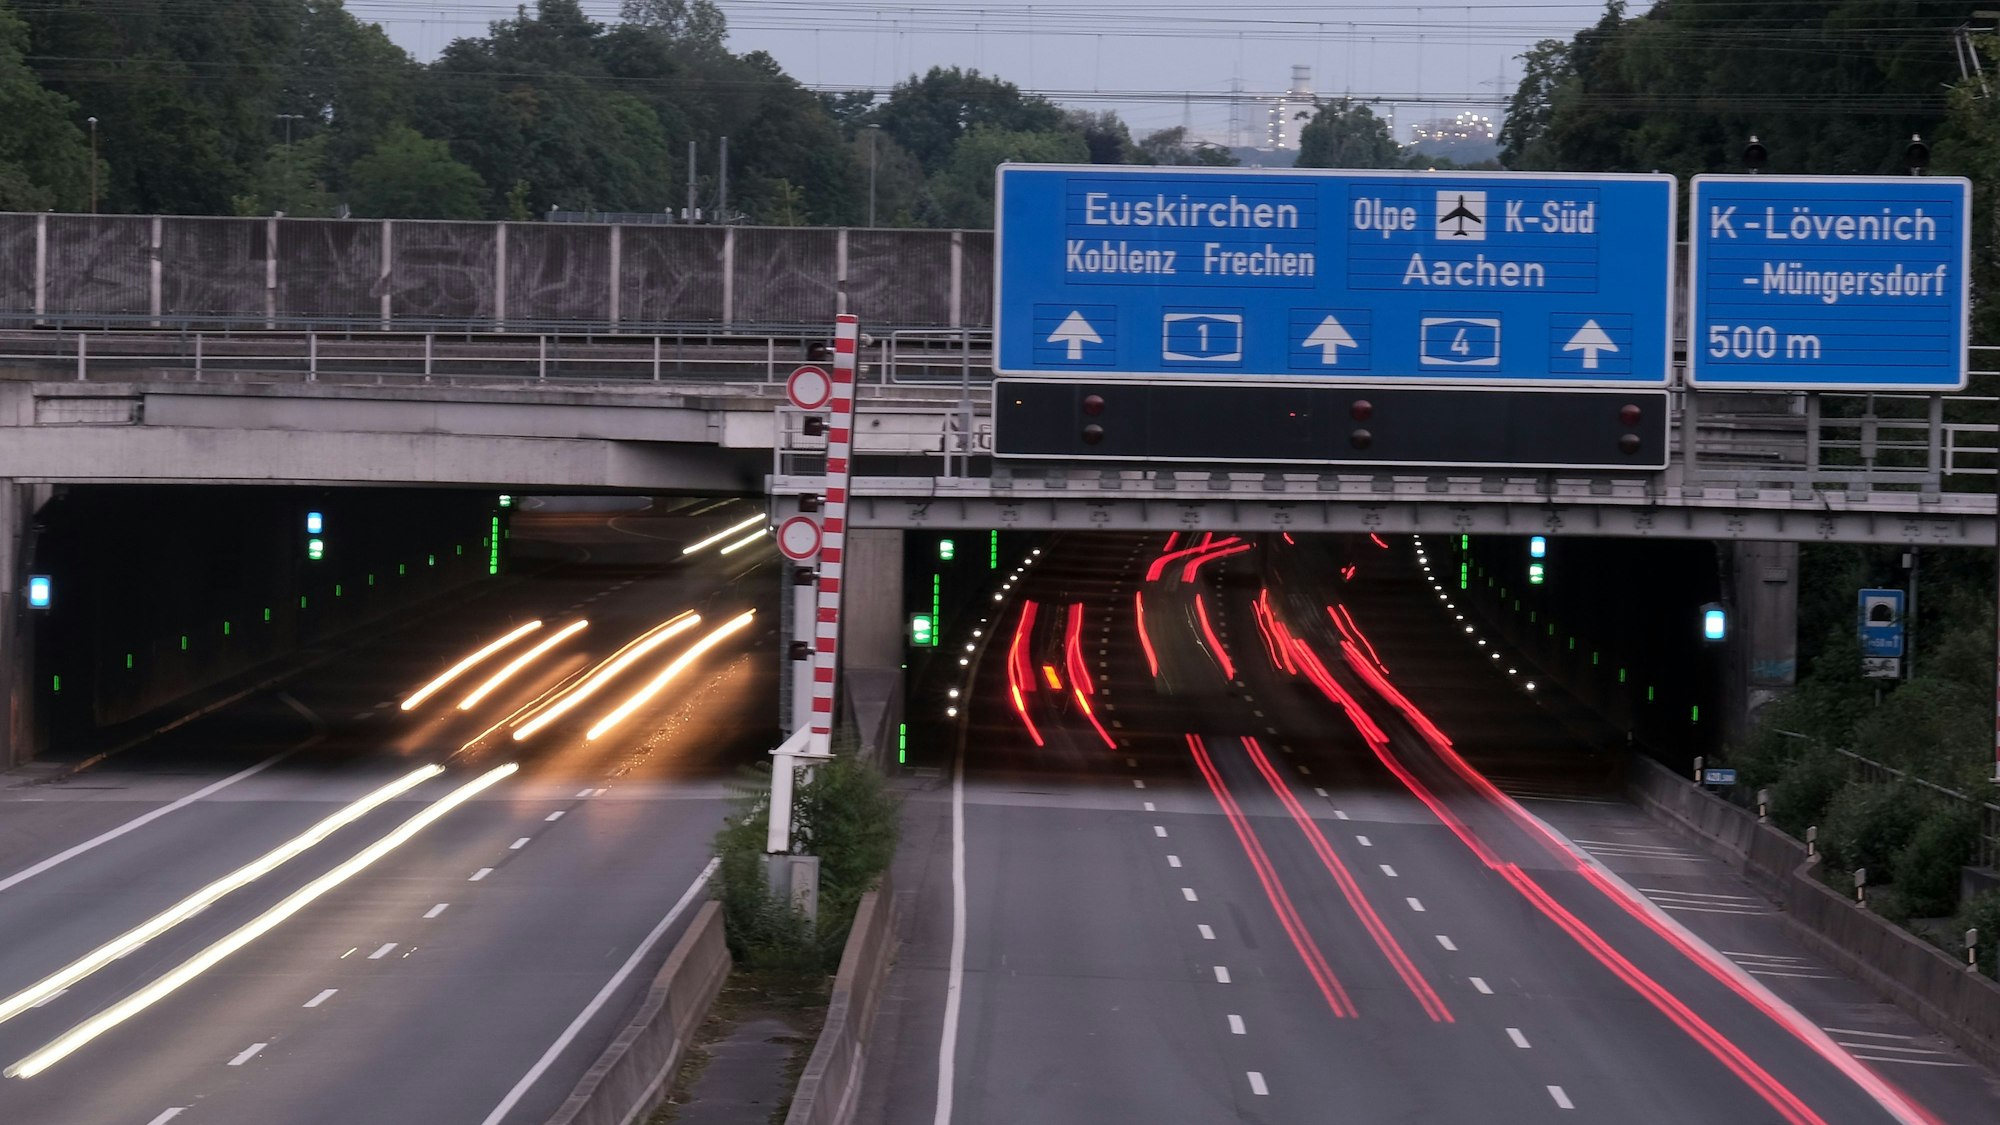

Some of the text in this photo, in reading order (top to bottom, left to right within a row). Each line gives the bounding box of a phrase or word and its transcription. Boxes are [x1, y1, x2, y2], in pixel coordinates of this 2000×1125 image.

[1086, 193, 1298, 228] Euskirchen
[1354, 197, 1594, 239] Olpe K-Süd
[1066, 240, 1314, 276] Koblenz Frechen
[1402, 254, 1544, 287] Aachen
[1743, 262, 1946, 304] -Müngersdorf
[1197, 323, 1209, 352] 1
[1450, 328, 1469, 355] 4
[1709, 325, 1820, 359] 500 m
